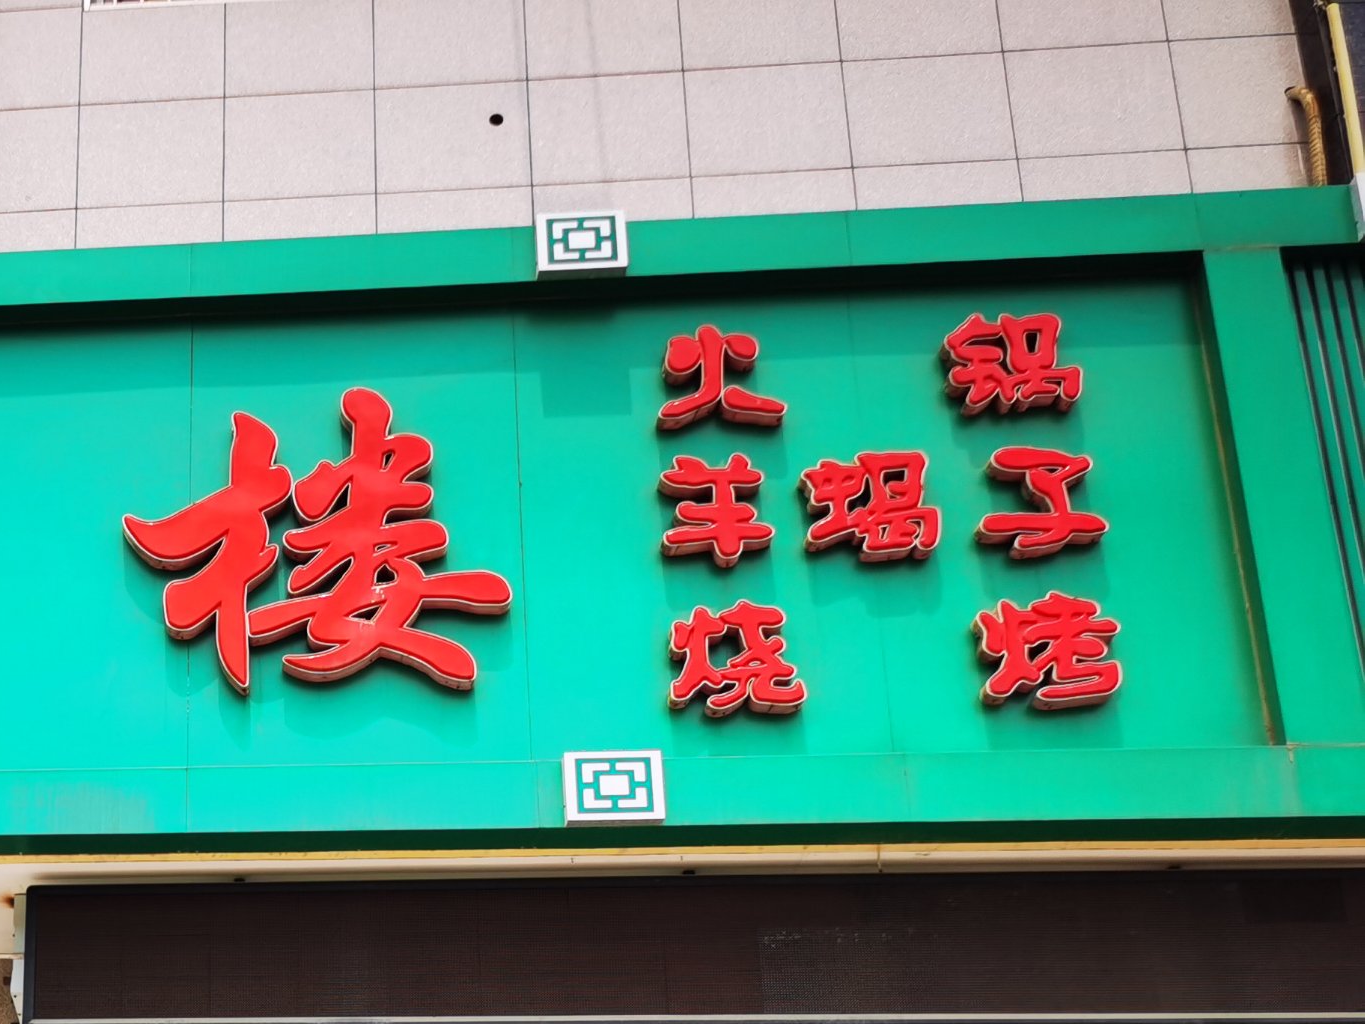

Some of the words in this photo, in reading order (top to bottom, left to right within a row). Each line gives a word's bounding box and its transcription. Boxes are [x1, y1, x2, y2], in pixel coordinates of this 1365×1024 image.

[656, 312, 1084, 430] 火锅
[658, 446, 1110, 569] 羊蝎子
[667, 591, 1123, 718] 烧烤
